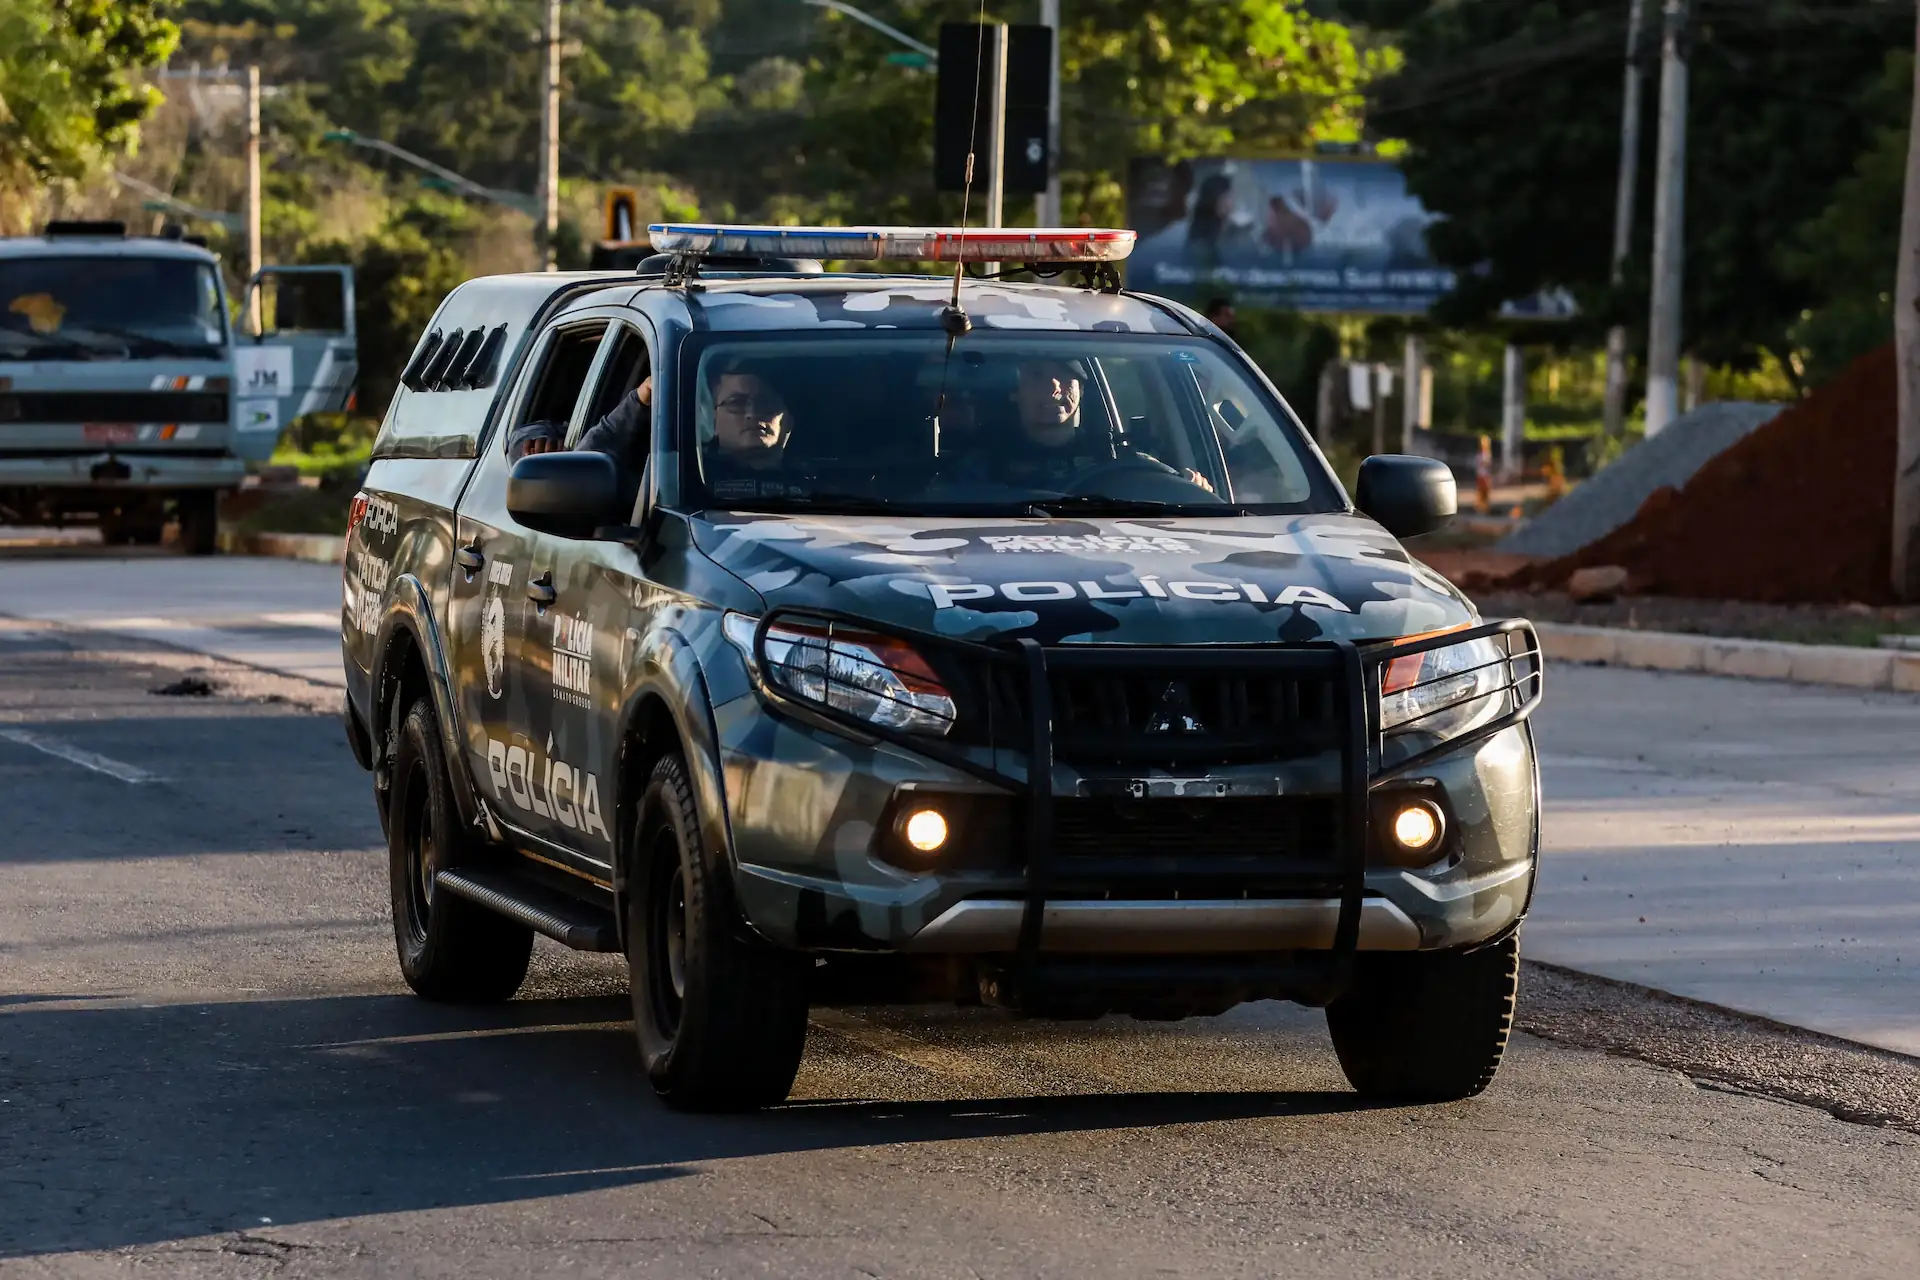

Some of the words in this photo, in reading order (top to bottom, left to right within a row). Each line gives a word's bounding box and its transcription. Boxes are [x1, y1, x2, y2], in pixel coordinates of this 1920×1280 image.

[248, 369, 278, 388] JM
[363, 496, 398, 544] FORÇA
[357, 542, 389, 592] TÁTICA
[924, 575, 1352, 612] POLÍCIA
[553, 610, 593, 656] PLÍCIA
[552, 652, 591, 695] MILITAR
[488, 730, 611, 842] POLÍCIA
